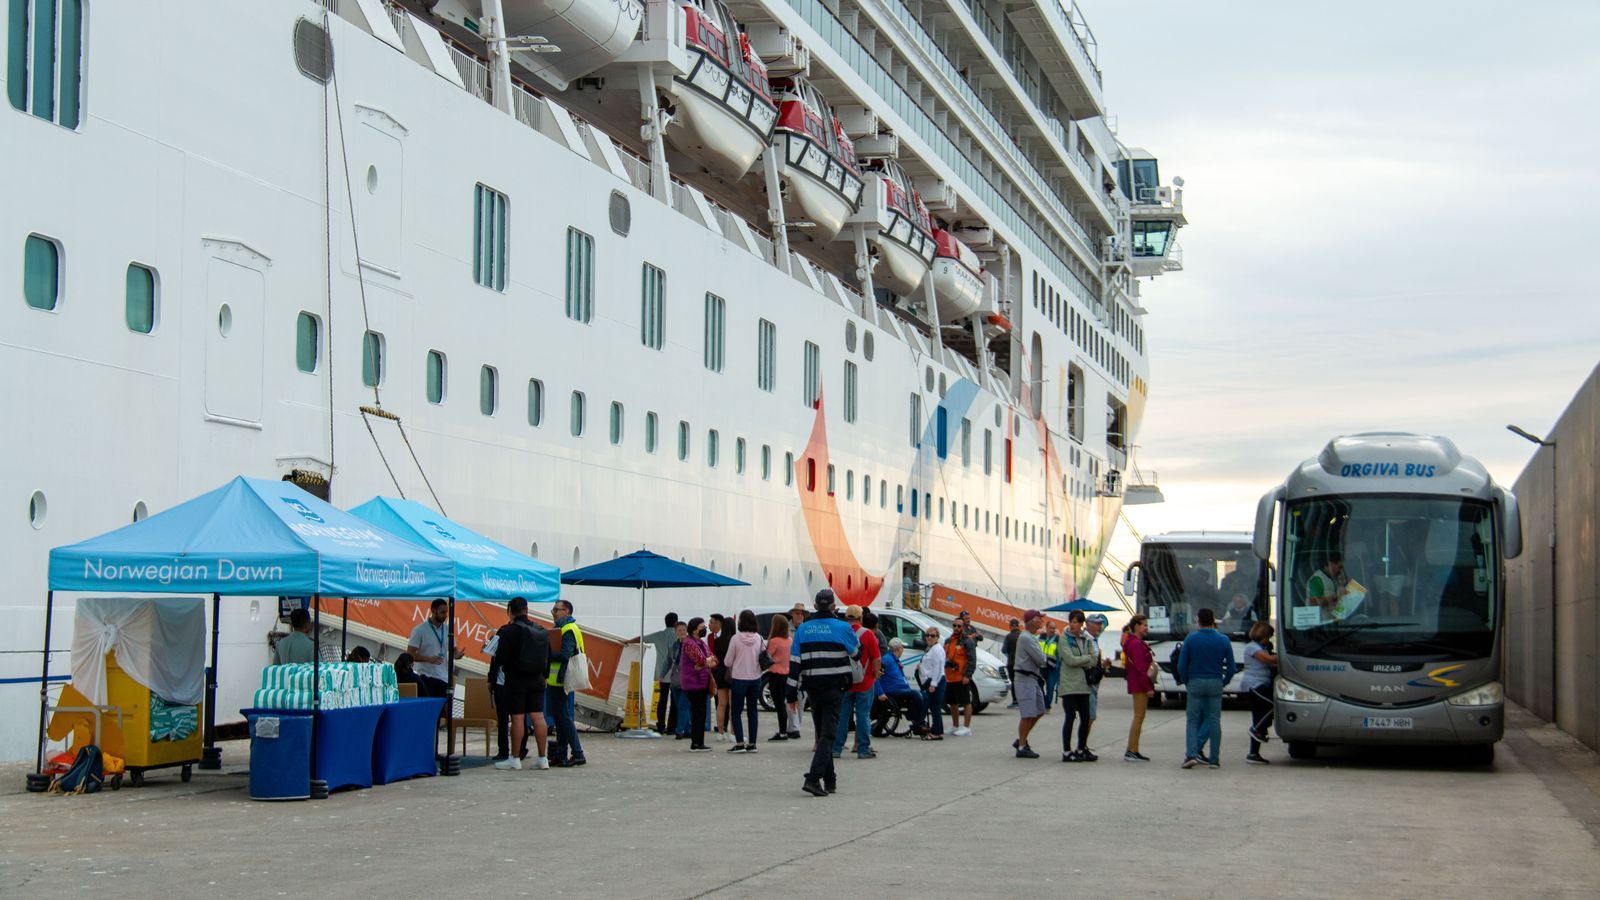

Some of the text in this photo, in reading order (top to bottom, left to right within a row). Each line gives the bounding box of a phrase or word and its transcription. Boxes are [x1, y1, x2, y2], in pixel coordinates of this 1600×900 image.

[1341, 462, 1436, 478] ORGIVA BUS
[84, 557, 283, 585] Norwegian Dawn
[356, 561, 426, 588] Norwegian Dawn
[482, 572, 538, 596] Norwegian Dawn
[1373, 664, 1402, 672] IRIZAR
[1370, 719, 1391, 727] 7447
